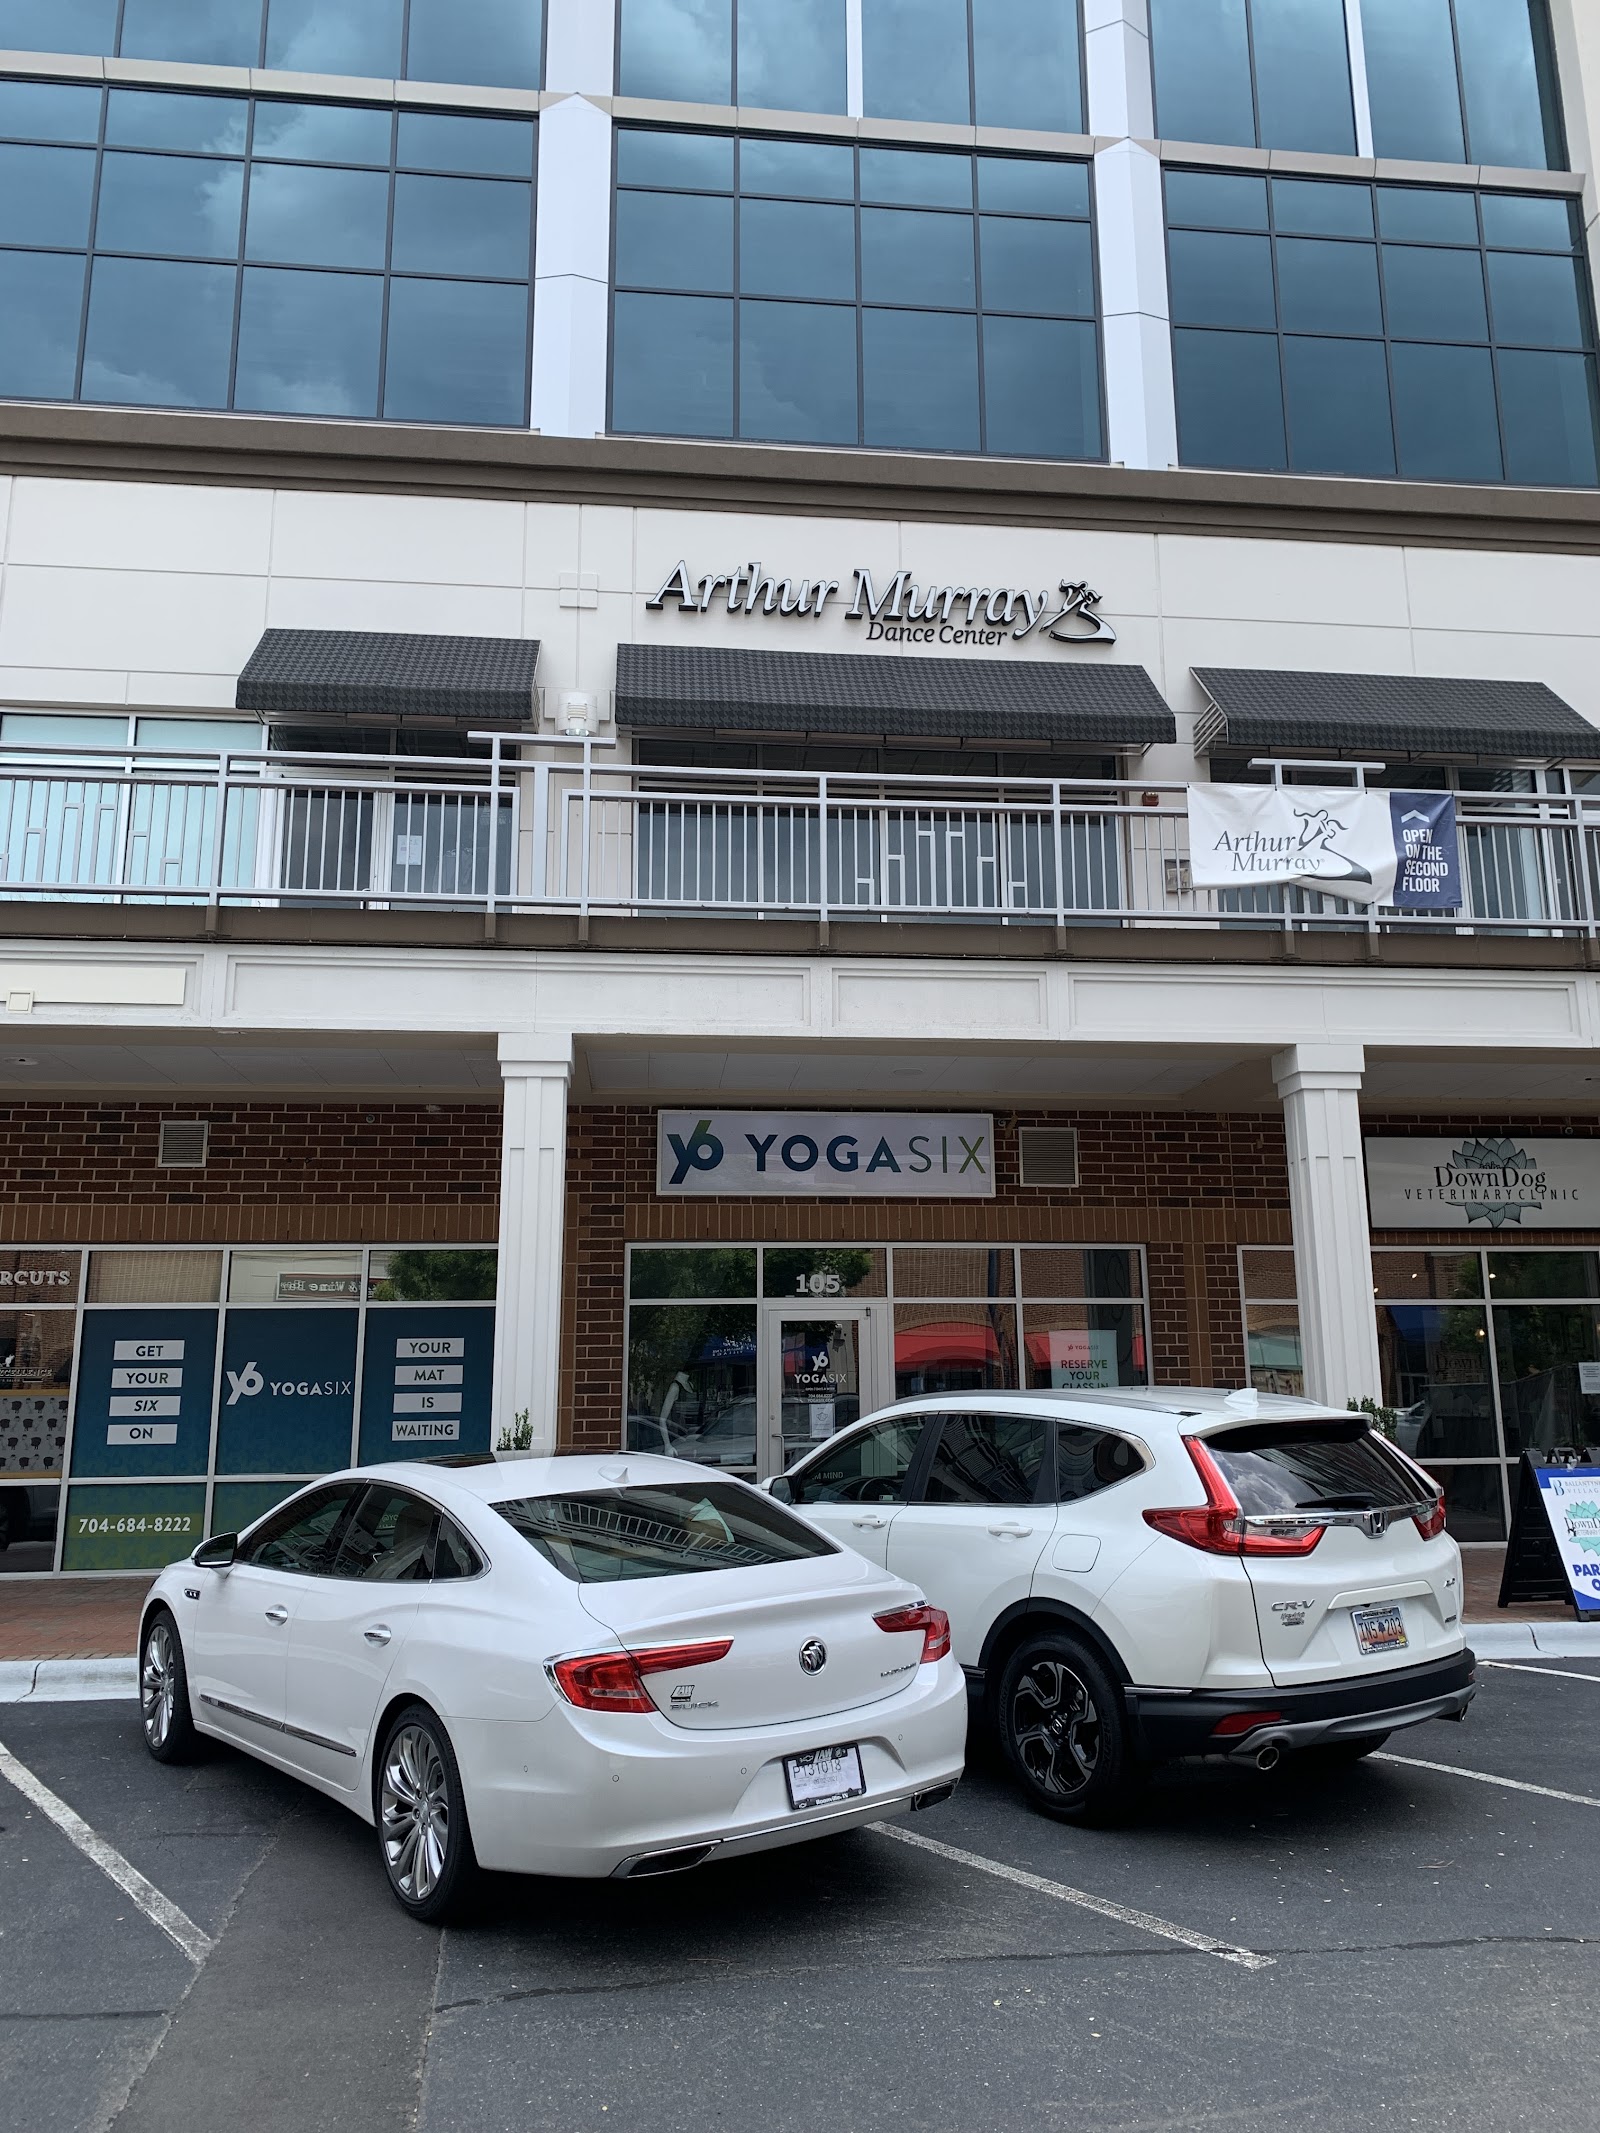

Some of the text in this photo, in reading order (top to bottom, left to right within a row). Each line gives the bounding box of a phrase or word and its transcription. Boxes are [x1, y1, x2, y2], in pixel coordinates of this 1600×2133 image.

[645, 559, 1049, 641] Arthur Murray
[866, 621, 1007, 647] Dance Center
[1212, 830, 1296, 852] Arthur
[1402, 828, 1433, 844] OPEN
[1405, 843, 1444, 861] ON THE
[1231, 852, 1320, 873] Murray
[1404, 859, 1449, 877] SECOND
[1402, 876, 1440, 893] FLOOR
[796, 1273, 840, 1293] 105
[135, 1345, 164, 1358] GET
[409, 1341, 451, 1354] YOUR
[1061, 1359, 1108, 1369] RESERVE
[125, 1372, 169, 1385] YOUR
[413, 1369, 445, 1382] MAT
[794, 1373, 847, 1384] YOGASIX
[1069, 1371, 1100, 1380] YOUR
[269, 1380, 352, 1396] YOGASIX
[133, 1399, 160, 1412] SIX
[421, 1397, 434, 1409] IS
[129, 1427, 153, 1440] ON
[395, 1424, 454, 1437] WAITING
[79, 1516, 191, 1533] 704-684-8222
[1572, 1563, 1600, 1577] PAR
[1271, 1599, 1315, 1612] CR-V
[670, 1700, 719, 1710] BUICK
